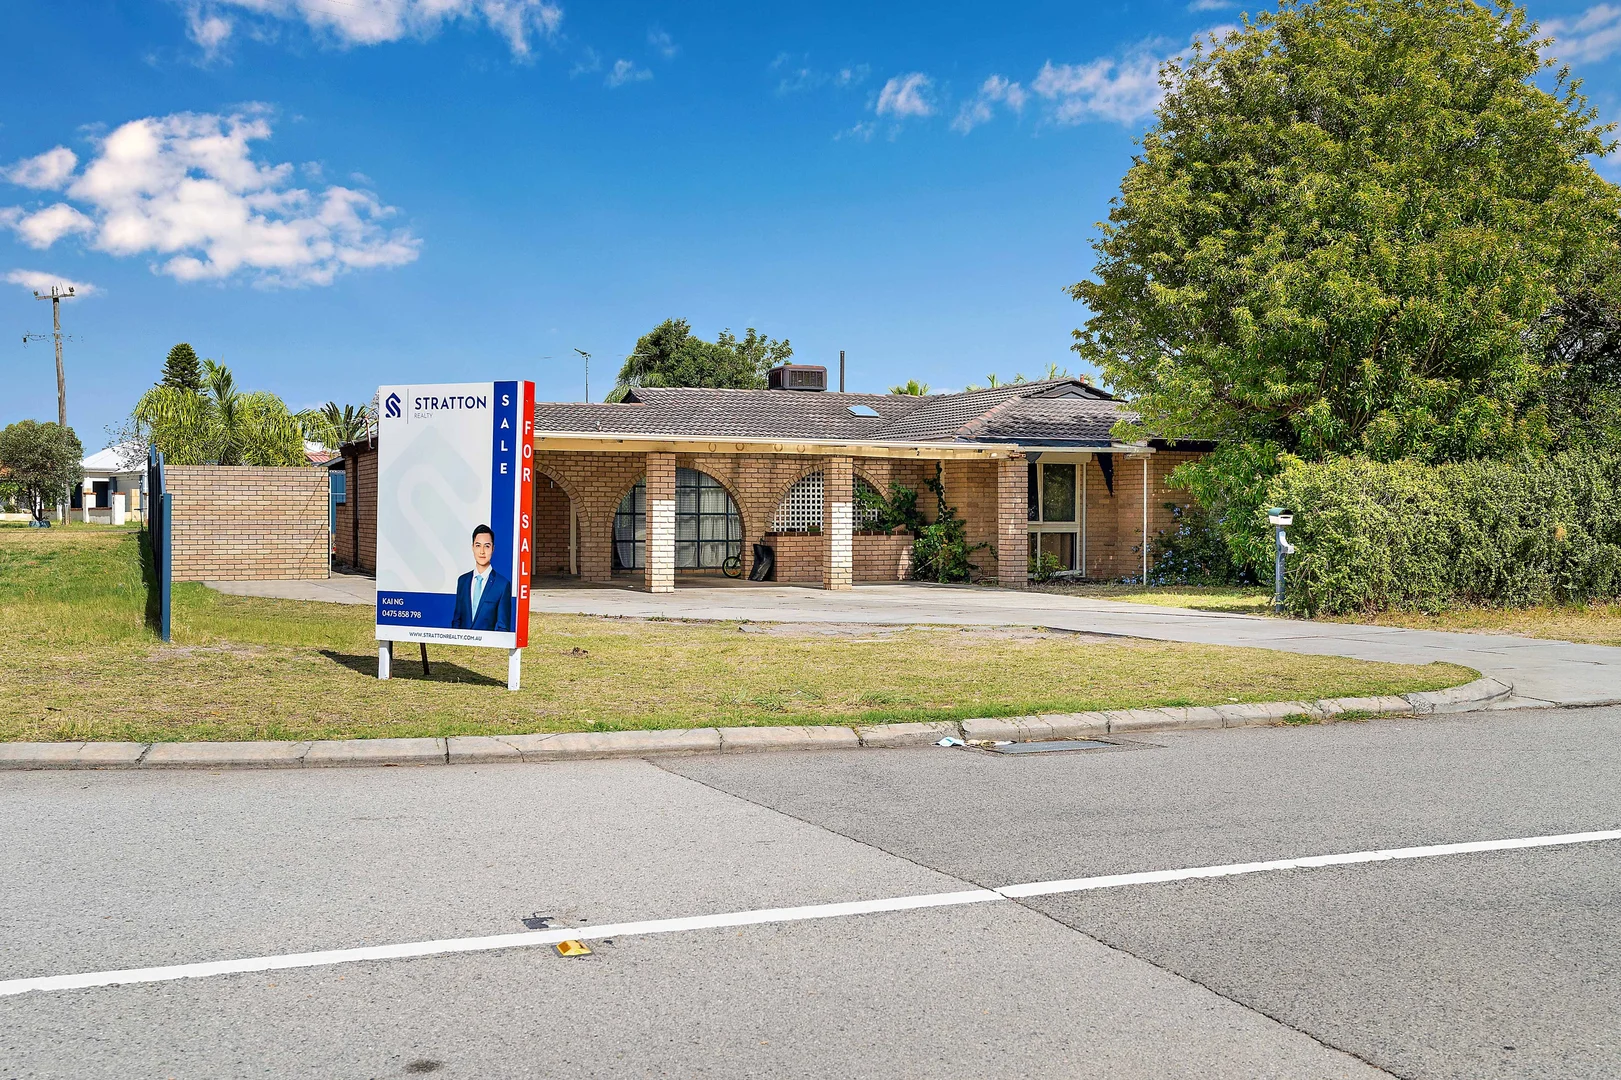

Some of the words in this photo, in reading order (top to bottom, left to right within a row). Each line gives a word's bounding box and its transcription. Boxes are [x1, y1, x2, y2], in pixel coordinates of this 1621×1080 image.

[414, 396, 486, 410] STRATTON
[500, 394, 510, 474] SALE
[523, 420, 532, 482] FOR
[520, 514, 529, 599] SALE
[409, 632, 482, 641] WWW.STRATTONREALTY.COM.AU
